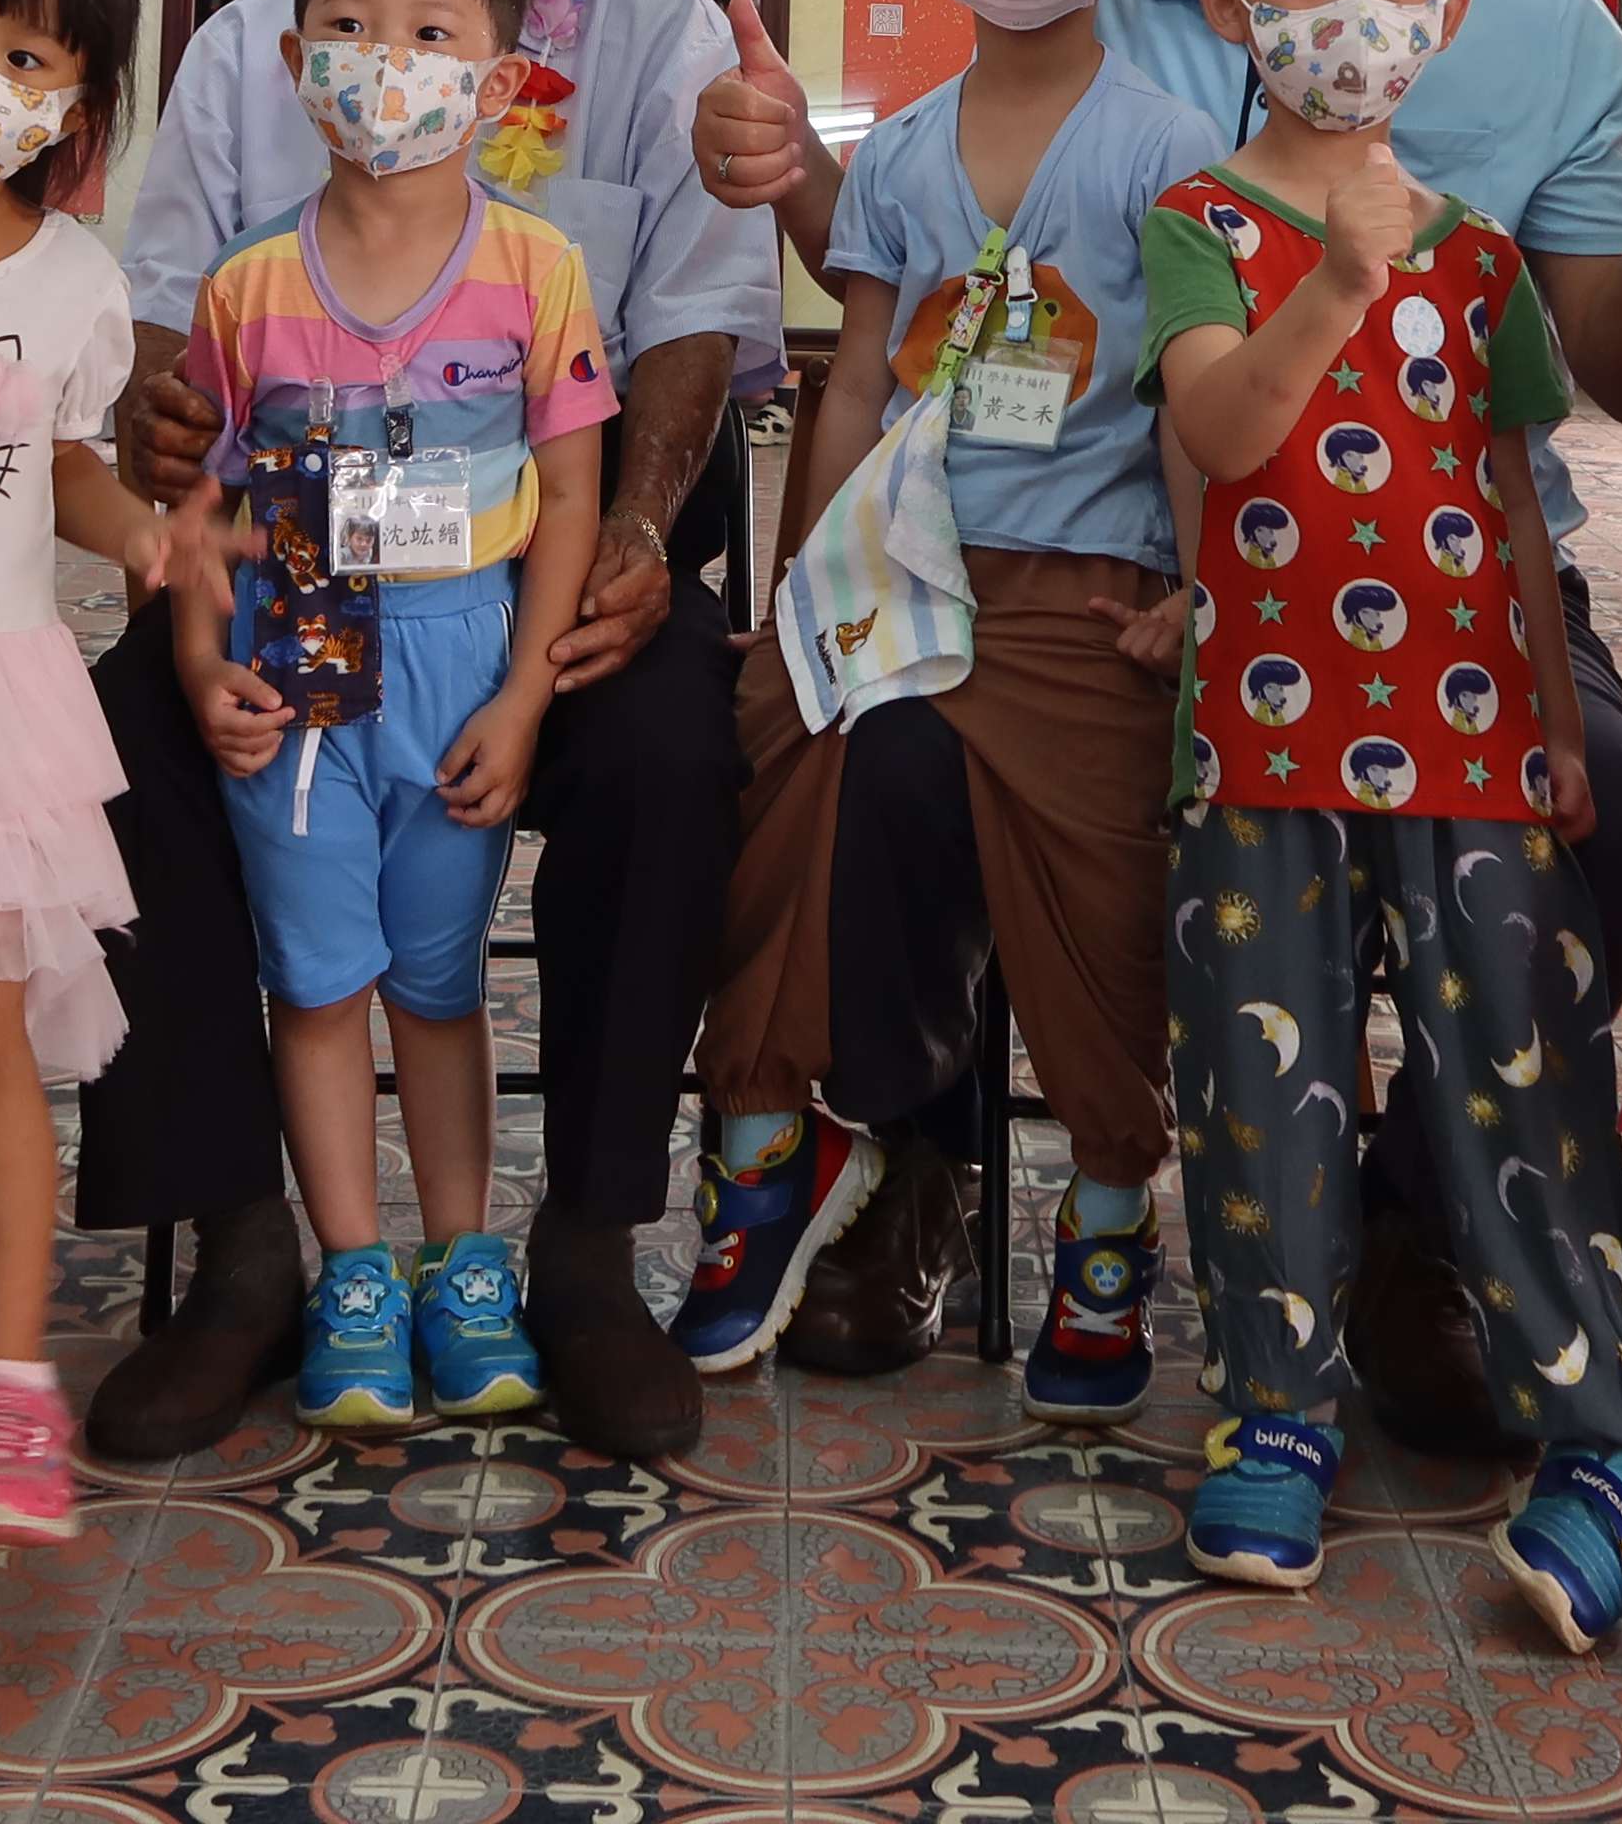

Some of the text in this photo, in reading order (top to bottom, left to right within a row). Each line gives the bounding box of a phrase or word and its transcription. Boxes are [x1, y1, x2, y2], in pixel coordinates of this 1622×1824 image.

[983, 396, 1054, 425] 黃之禾
[1255, 1428, 1323, 1467] buffalo
